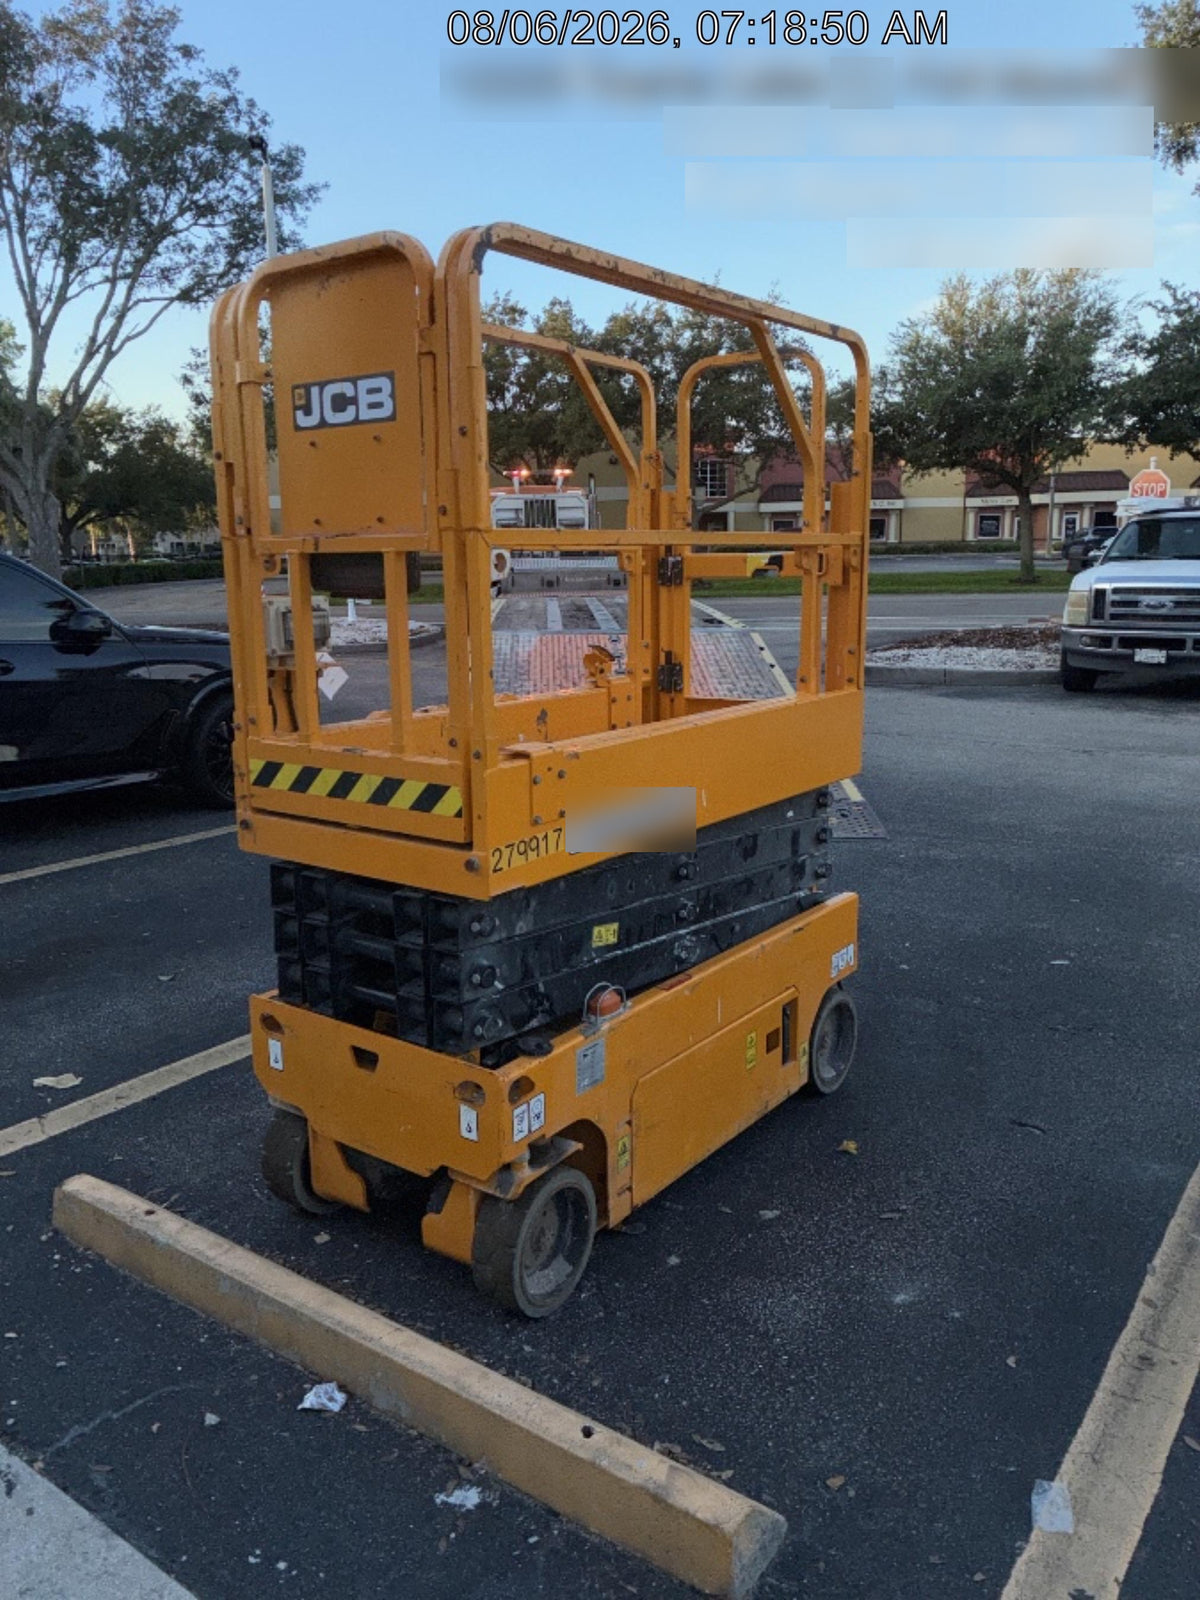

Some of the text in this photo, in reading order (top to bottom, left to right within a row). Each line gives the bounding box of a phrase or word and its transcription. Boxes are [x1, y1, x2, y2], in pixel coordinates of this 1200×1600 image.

[295, 376, 394, 428] JCB
[1133, 482, 1166, 497] STOP
[492, 827, 562, 873] 279917
